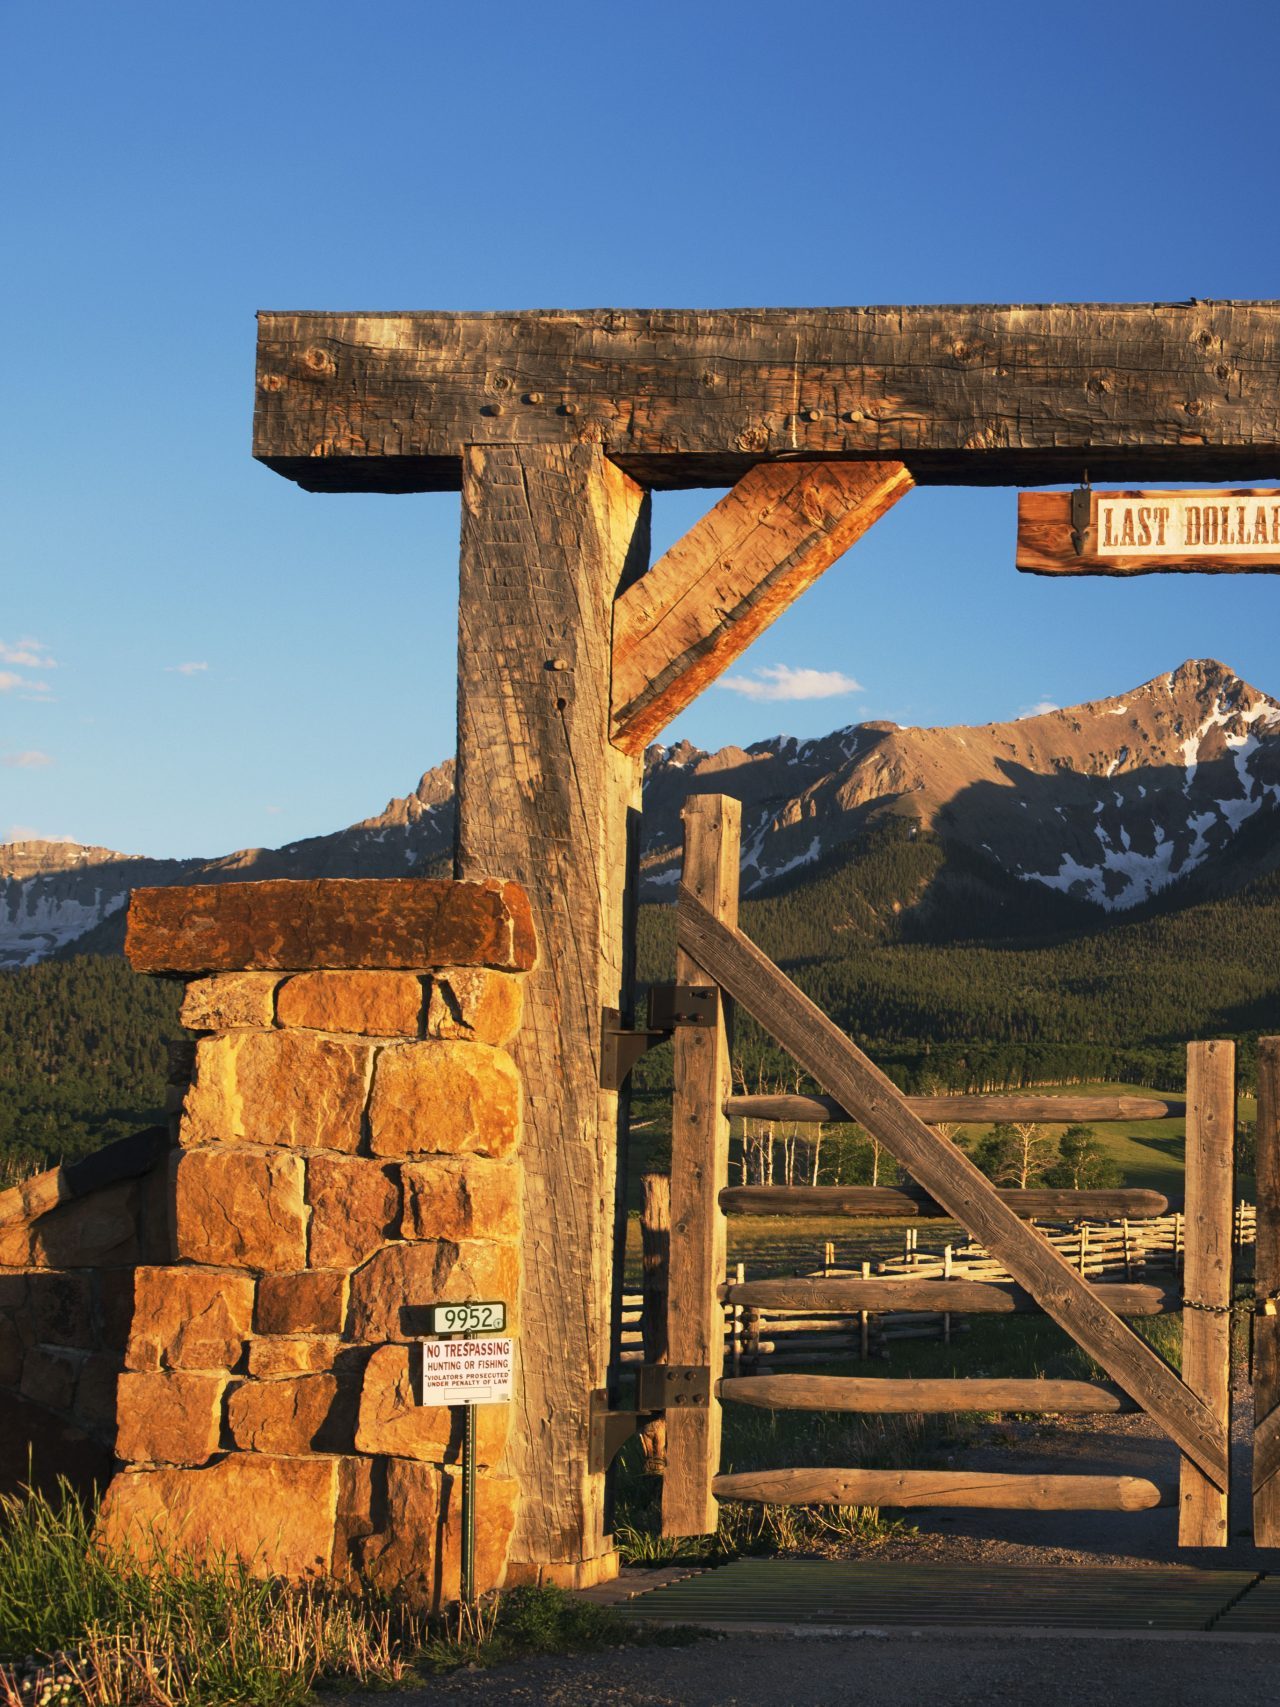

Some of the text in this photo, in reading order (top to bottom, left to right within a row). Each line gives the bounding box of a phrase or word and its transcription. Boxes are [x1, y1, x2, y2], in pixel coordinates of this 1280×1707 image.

[1103, 507, 1169, 547] LAST
[445, 1307, 492, 1329] 9952
[427, 1342, 510, 1358] NO TRESPASSING
[427, 1359, 509, 1371] HUNTING OR FISHING
